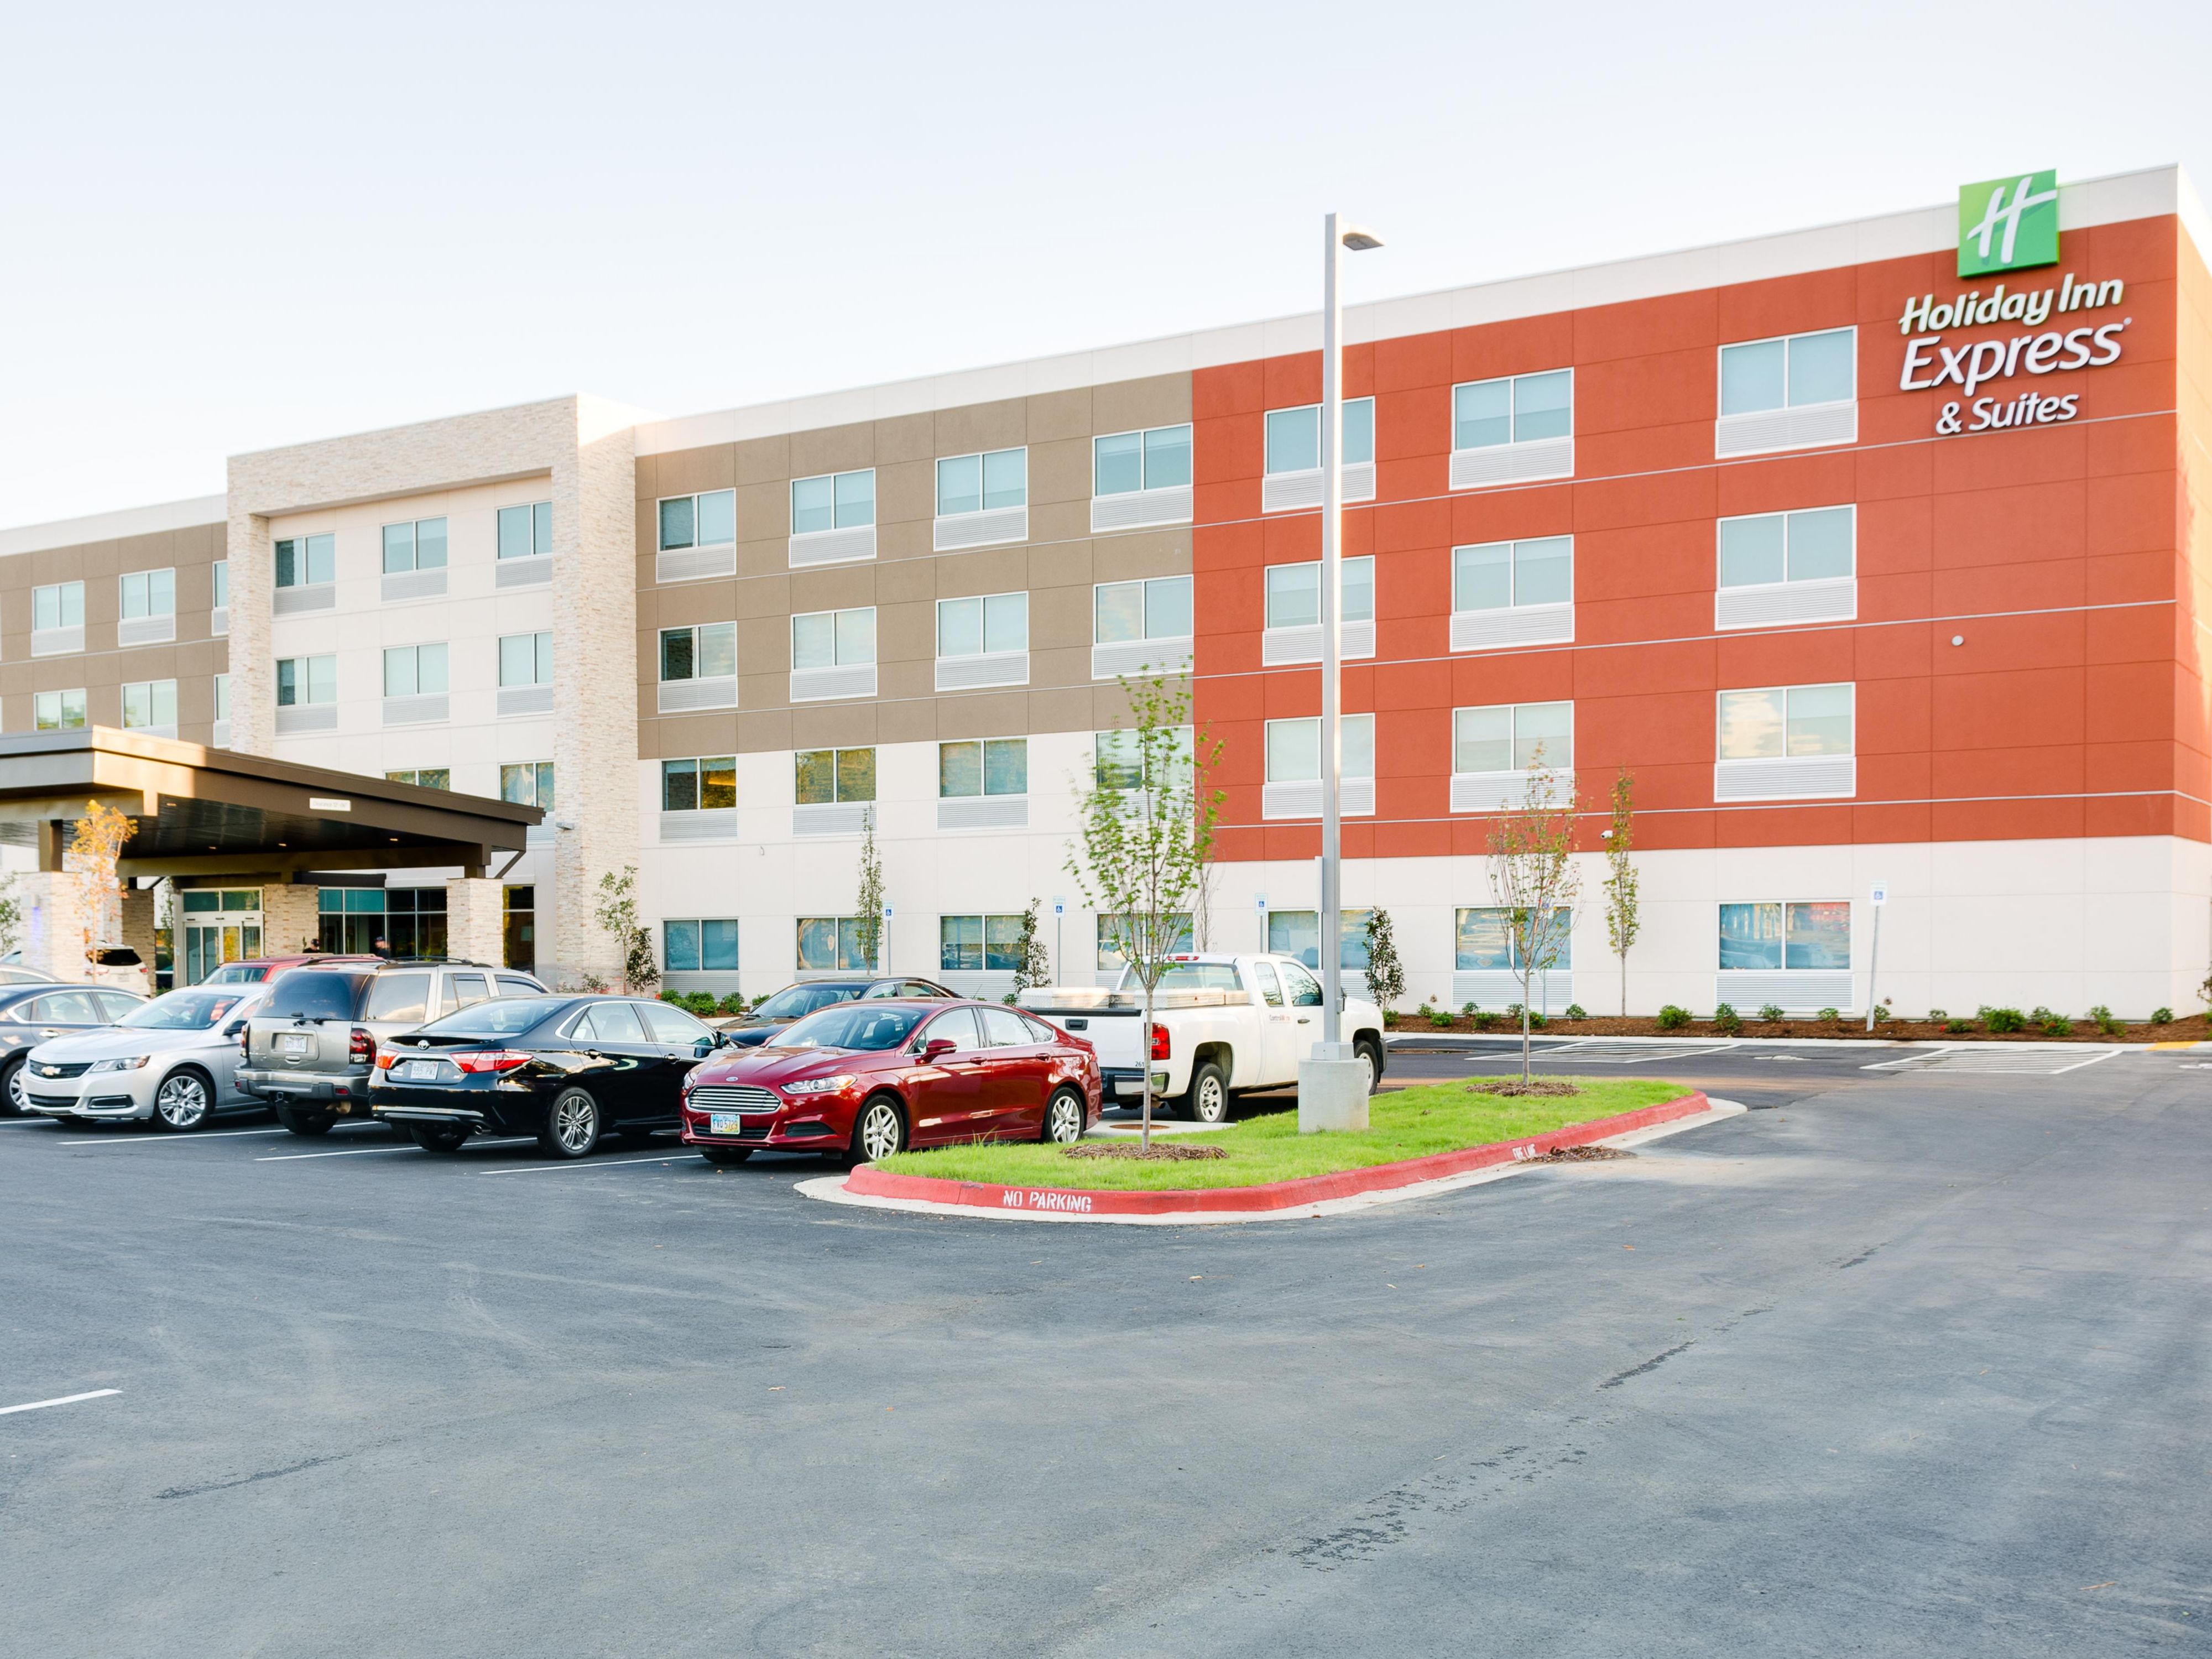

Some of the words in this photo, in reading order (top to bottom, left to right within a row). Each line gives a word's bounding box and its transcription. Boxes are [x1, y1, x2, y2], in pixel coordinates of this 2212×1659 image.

[1898, 284, 2054, 335] Holiday
[2058, 273, 2124, 312] Inn
[1900, 323, 2124, 397] Express
[1936, 401, 1962, 435] &
[1968, 392, 2079, 431] Suites
[1003, 1190, 1023, 1207] NO
[1029, 1191, 1092, 1213] PARKING
